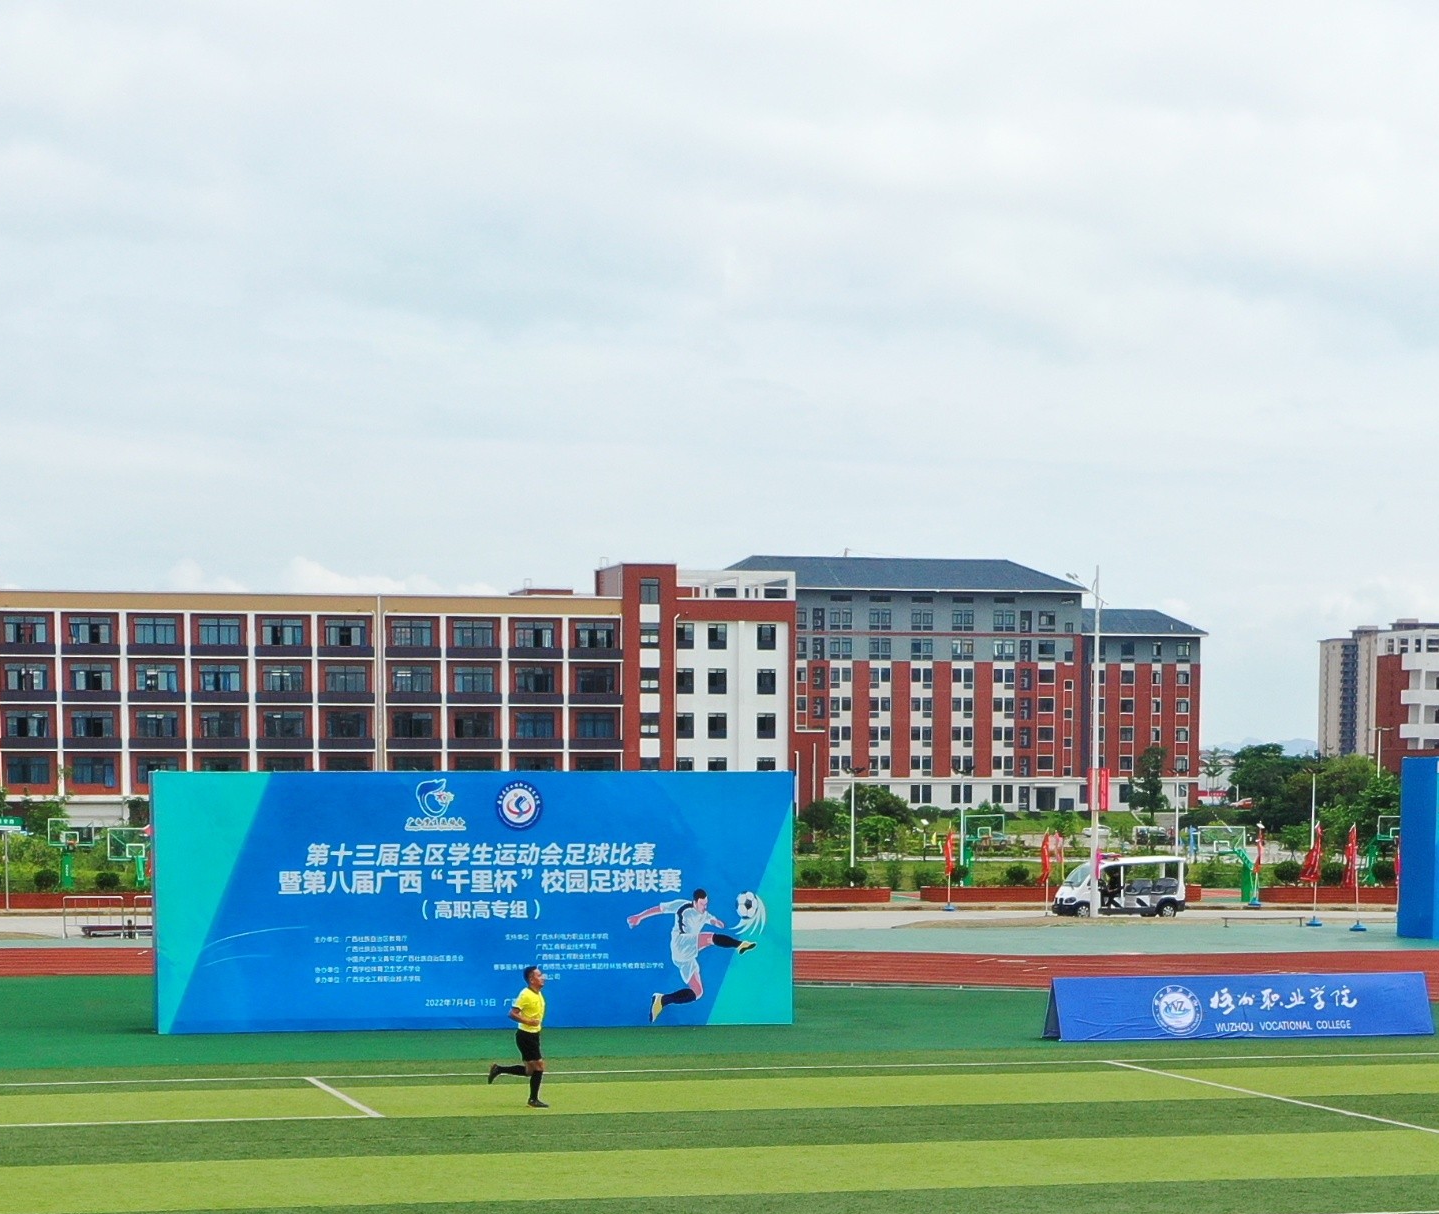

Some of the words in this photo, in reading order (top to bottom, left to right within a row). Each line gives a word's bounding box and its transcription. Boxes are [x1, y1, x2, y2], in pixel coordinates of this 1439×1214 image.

[305, 843, 656, 867] 第十三届全区学生运动会足球比赛
[1215, 1021, 1254, 1033] WUZHOU
[1259, 1020, 1312, 1032] VOCATIONAL
[1316, 1019, 1351, 1030] COLLEGE
